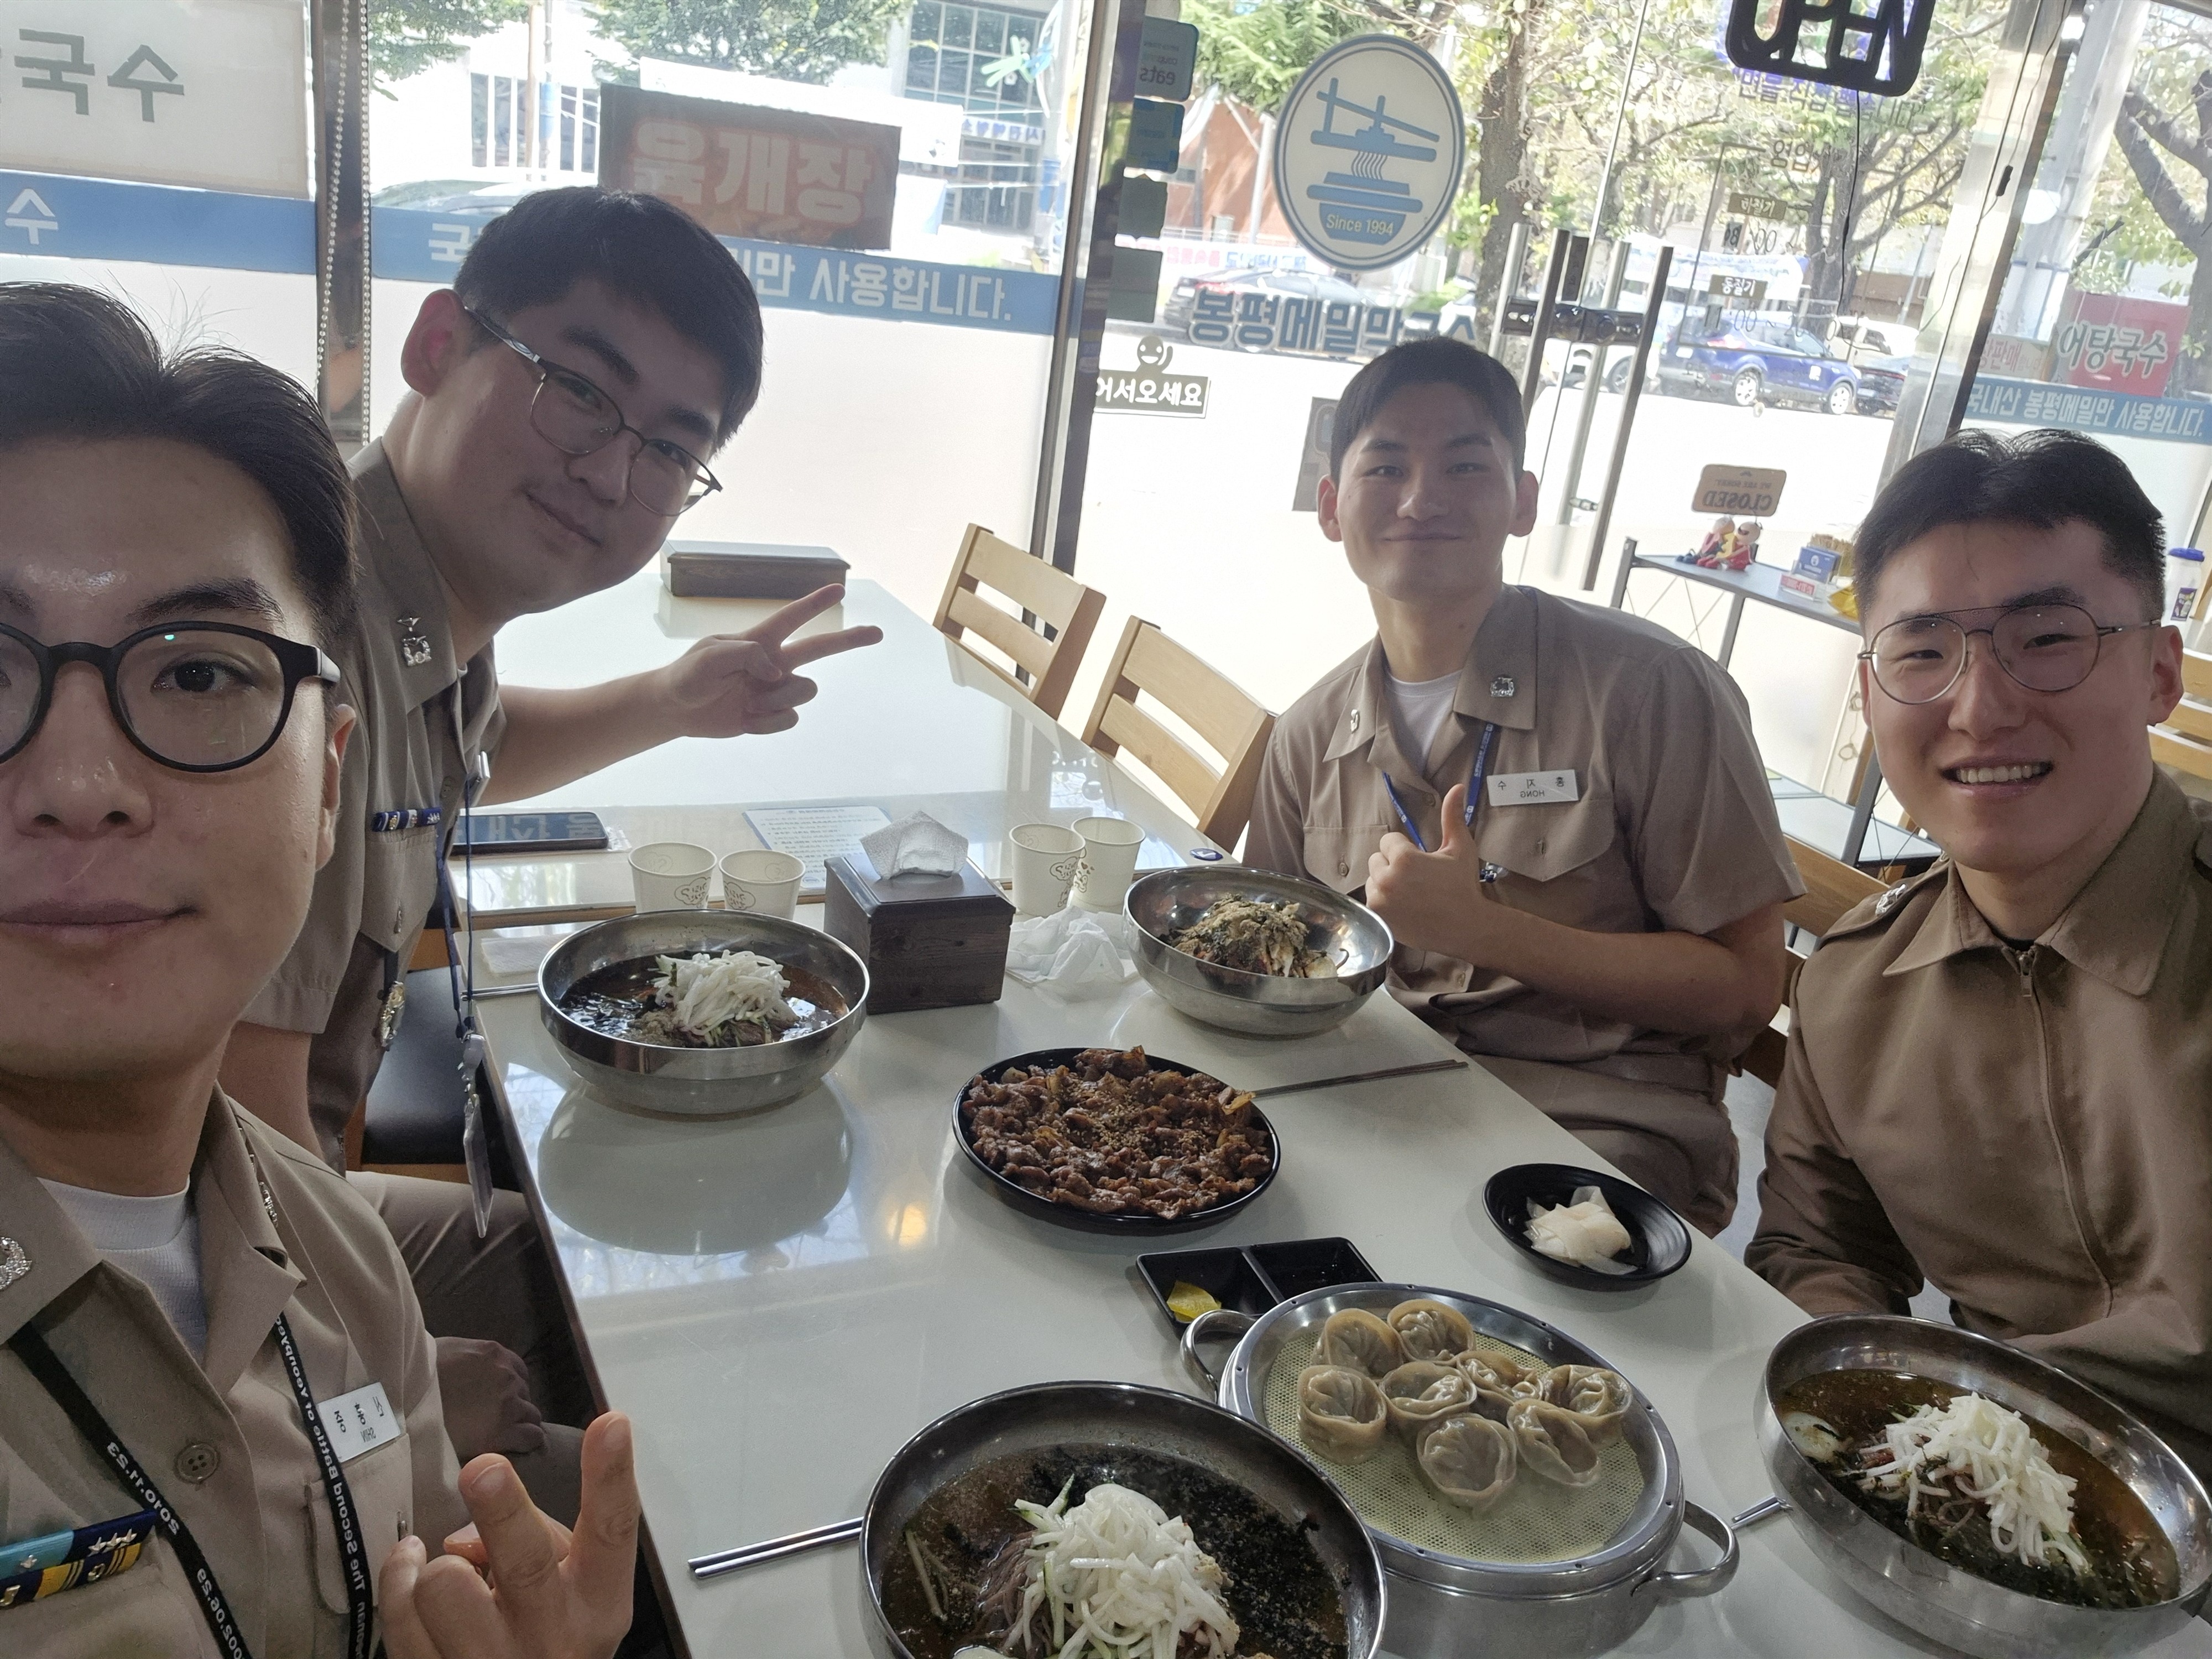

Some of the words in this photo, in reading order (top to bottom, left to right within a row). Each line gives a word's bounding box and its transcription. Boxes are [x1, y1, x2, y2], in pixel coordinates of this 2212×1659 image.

[1327, 213, 1362, 232] Since
[1365, 218, 1394, 236] 1994
[810, 258, 1011, 321] 사용합니다.
[1721, 276, 1756, 298] 동절기
[2059, 322, 2168, 378] 어탕국수
[1095, 377, 1203, 406] 어서오세요
[2023, 389, 2115, 427] 봉평메밀만
[2115, 400, 2205, 437] 사용합니다.
